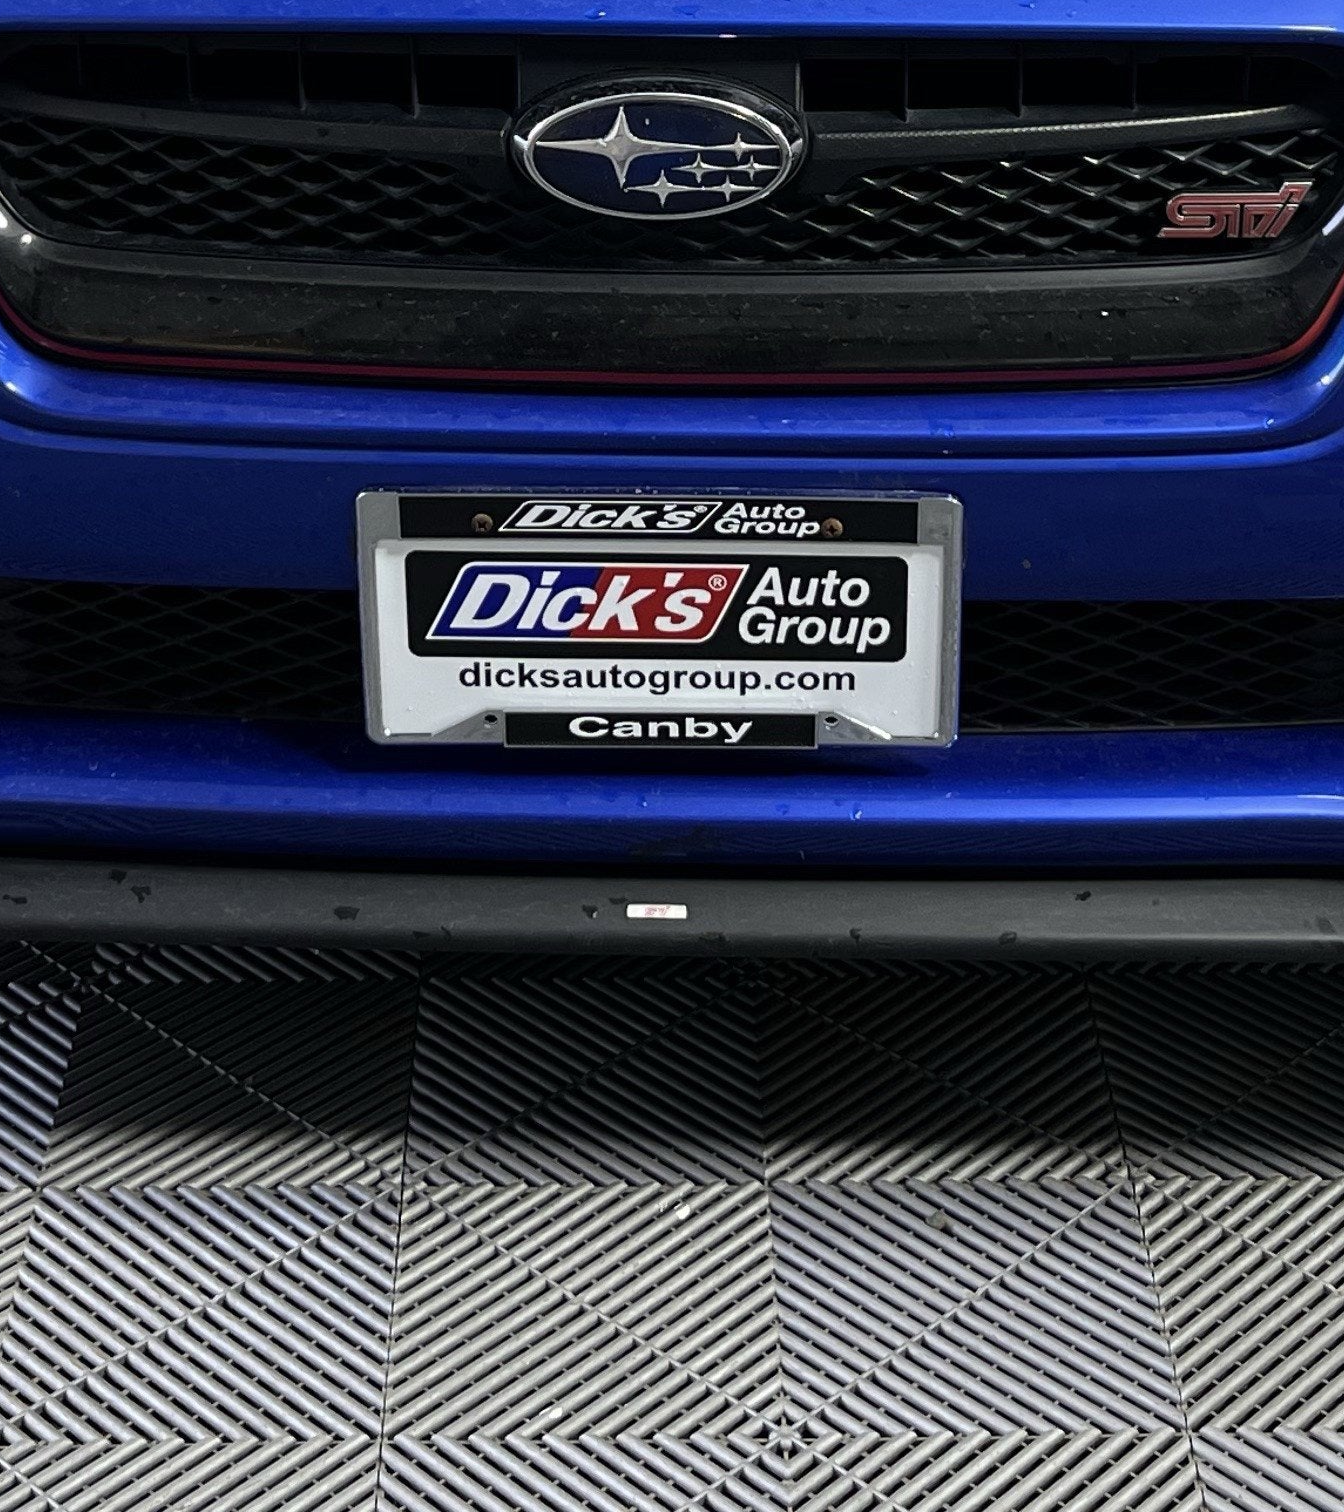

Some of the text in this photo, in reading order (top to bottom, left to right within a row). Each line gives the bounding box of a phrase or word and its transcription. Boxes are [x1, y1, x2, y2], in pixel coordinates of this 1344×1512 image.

[515, 502, 806, 529] Dick's Auto
[714, 518, 821, 537] Group
[449, 566, 870, 633] Dick's Auto
[738, 606, 892, 654] Group
[458, 661, 856, 696] dicksautogroup.com
[568, 716, 754, 743] Canby
